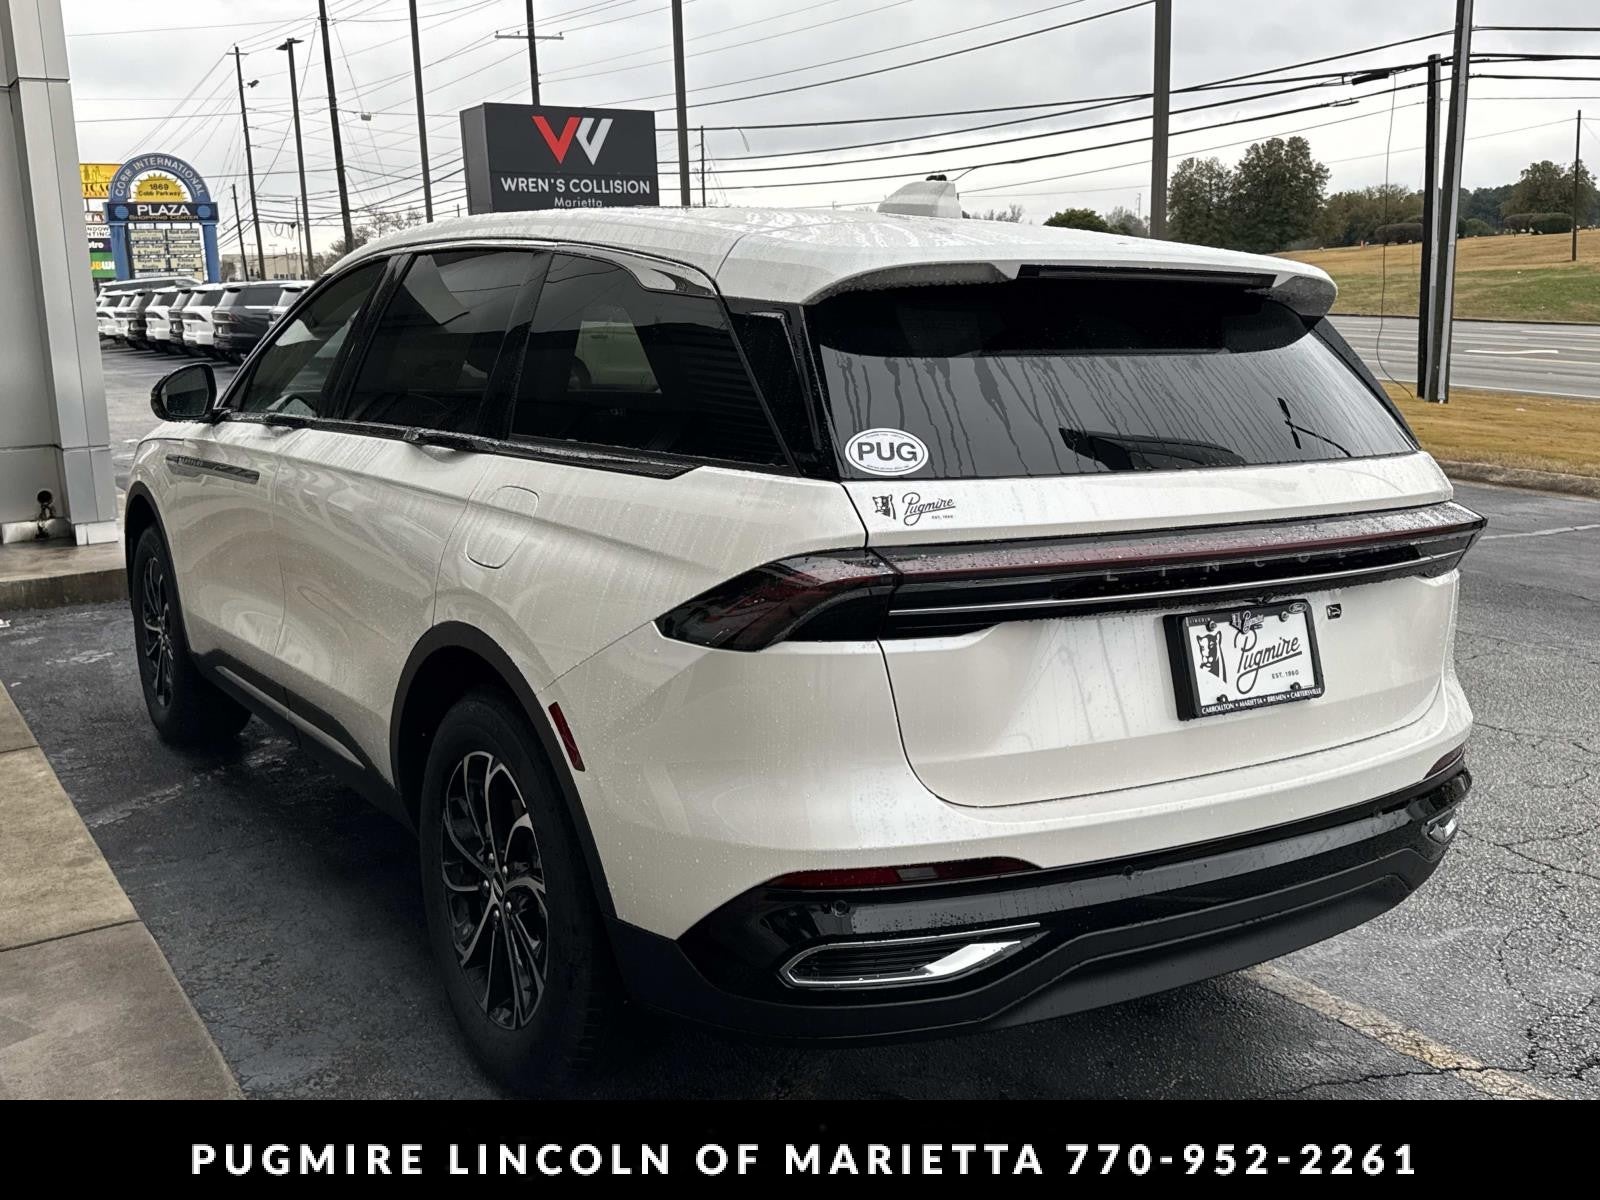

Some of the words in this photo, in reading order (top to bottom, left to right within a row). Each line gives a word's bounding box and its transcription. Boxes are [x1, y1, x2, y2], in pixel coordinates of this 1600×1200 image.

[115, 169, 133, 197] COBB
[133, 157, 206, 196] INTERNATIONAL
[501, 177, 566, 193] WREN'S
[569, 179, 651, 194] COLLISION
[136, 204, 191, 216] PLAZA
[554, 197, 603, 208] Marietta
[857, 441, 918, 462] PUG
[902, 491, 956, 526] Pugmire
[1233, 629, 1302, 694] Pugmire
[1271, 671, 1285, 680] EST.
[1285, 669, 1300, 678] 1960
[1239, 697, 1263, 707] MARIETTA
[1266, 693, 1287, 703] BREMEN
[1290, 687, 1322, 699] CARTERSVILLE
